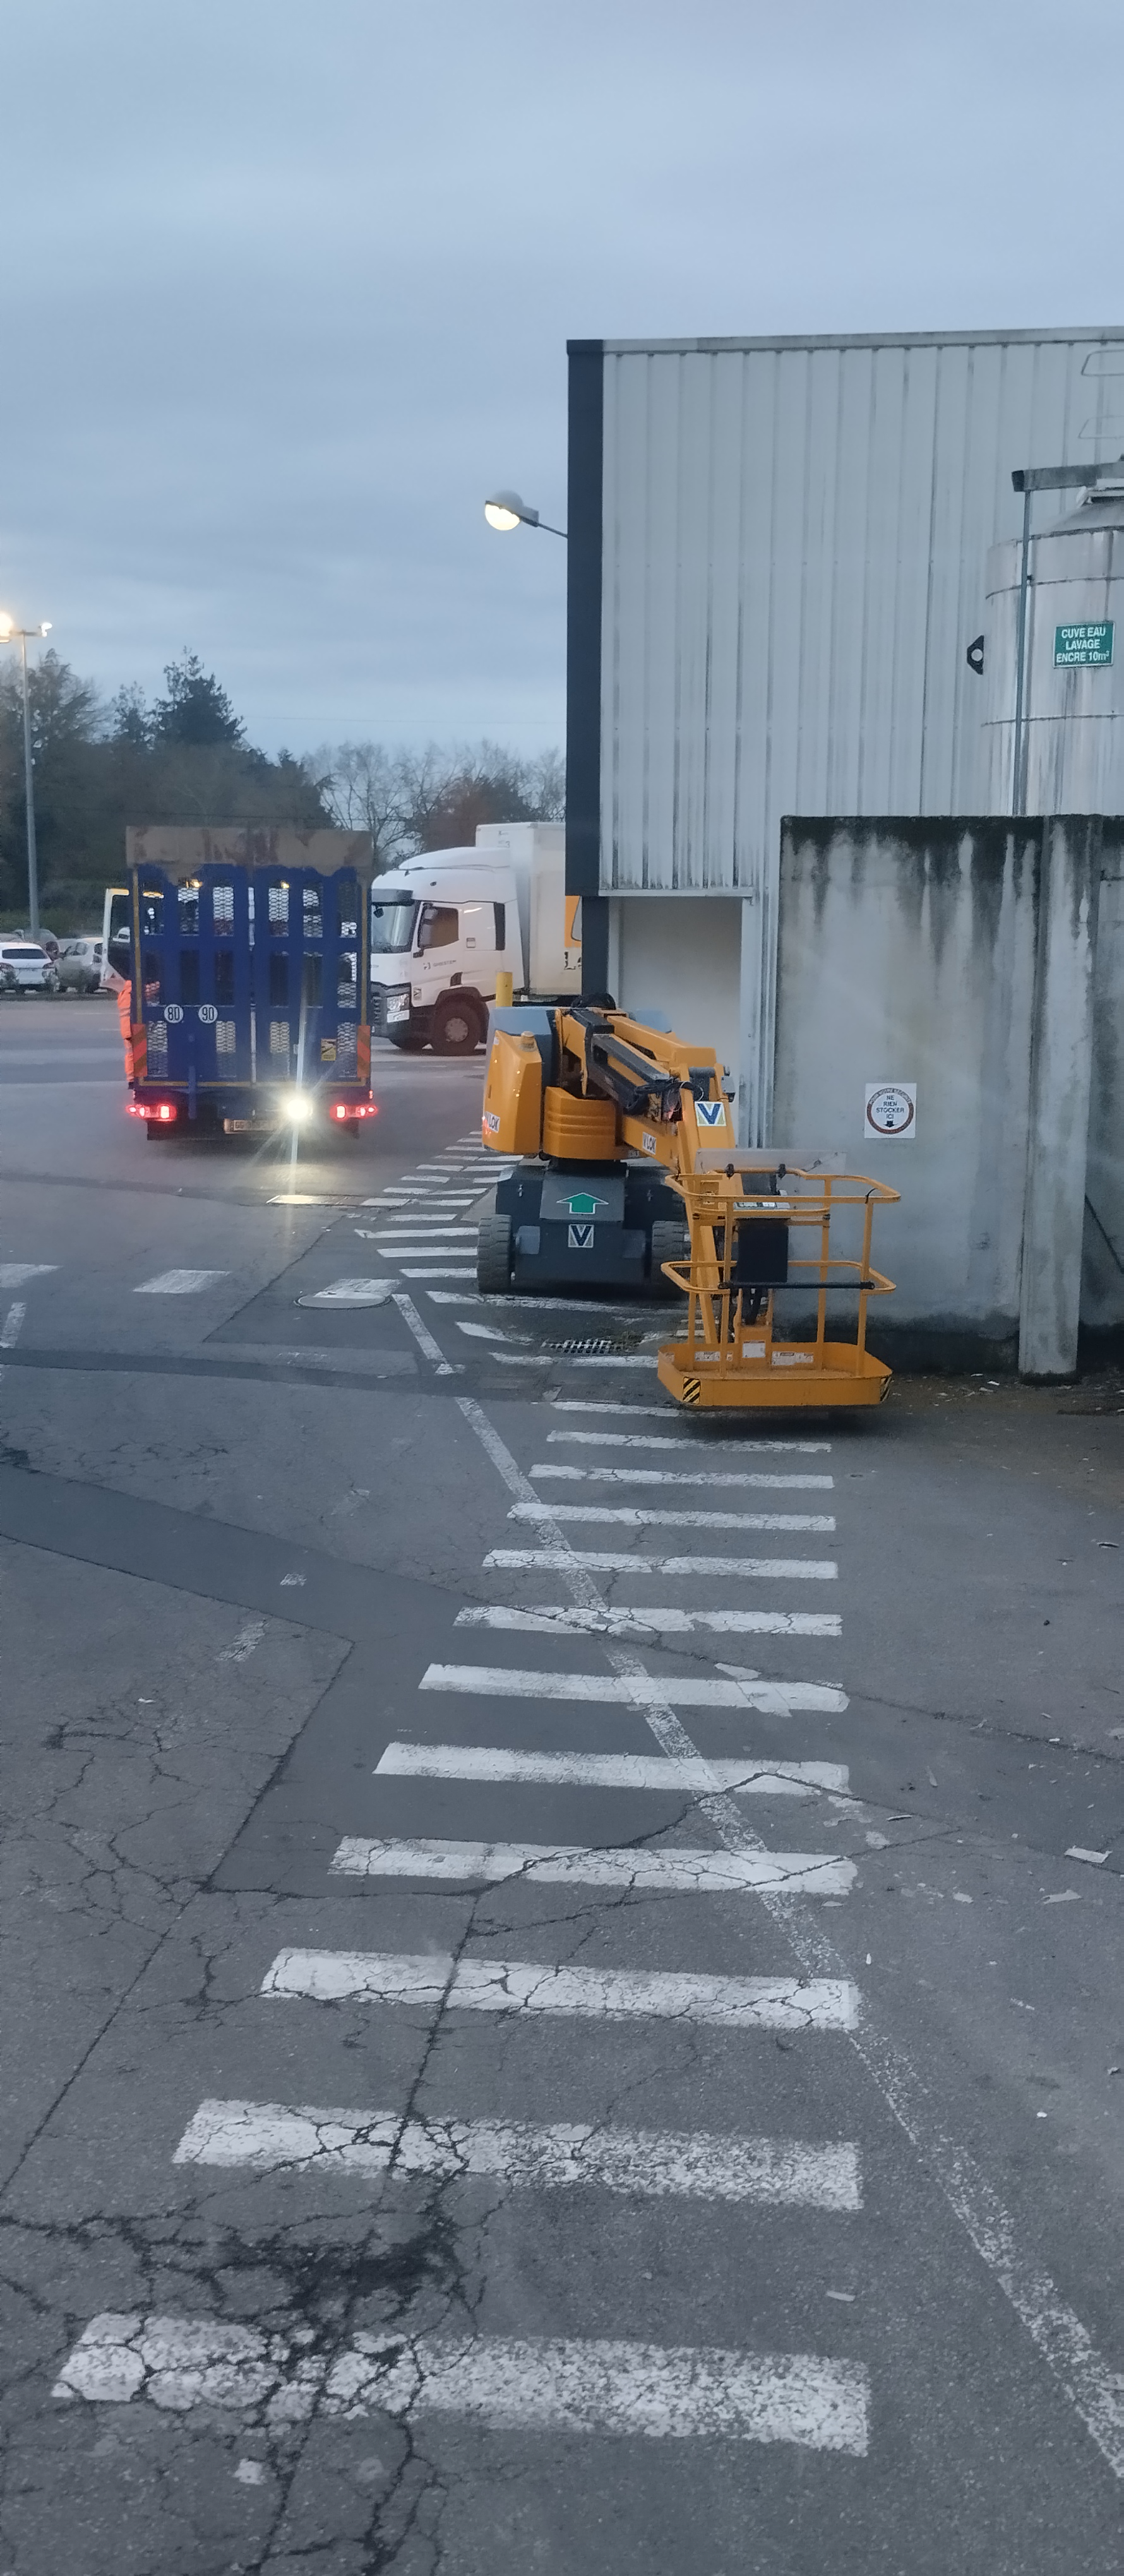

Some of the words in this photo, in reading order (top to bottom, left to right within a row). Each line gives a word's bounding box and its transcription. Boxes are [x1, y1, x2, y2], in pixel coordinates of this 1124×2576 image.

[1061, 628, 1085, 638] CUVE
[1087, 626, 1106, 637] EAU
[1066, 639, 1101, 650] LAVAGE
[1056, 652, 1086, 663] ENCRE
[168, 1006, 180, 1021] 80
[202, 1006, 214, 1021] 90
